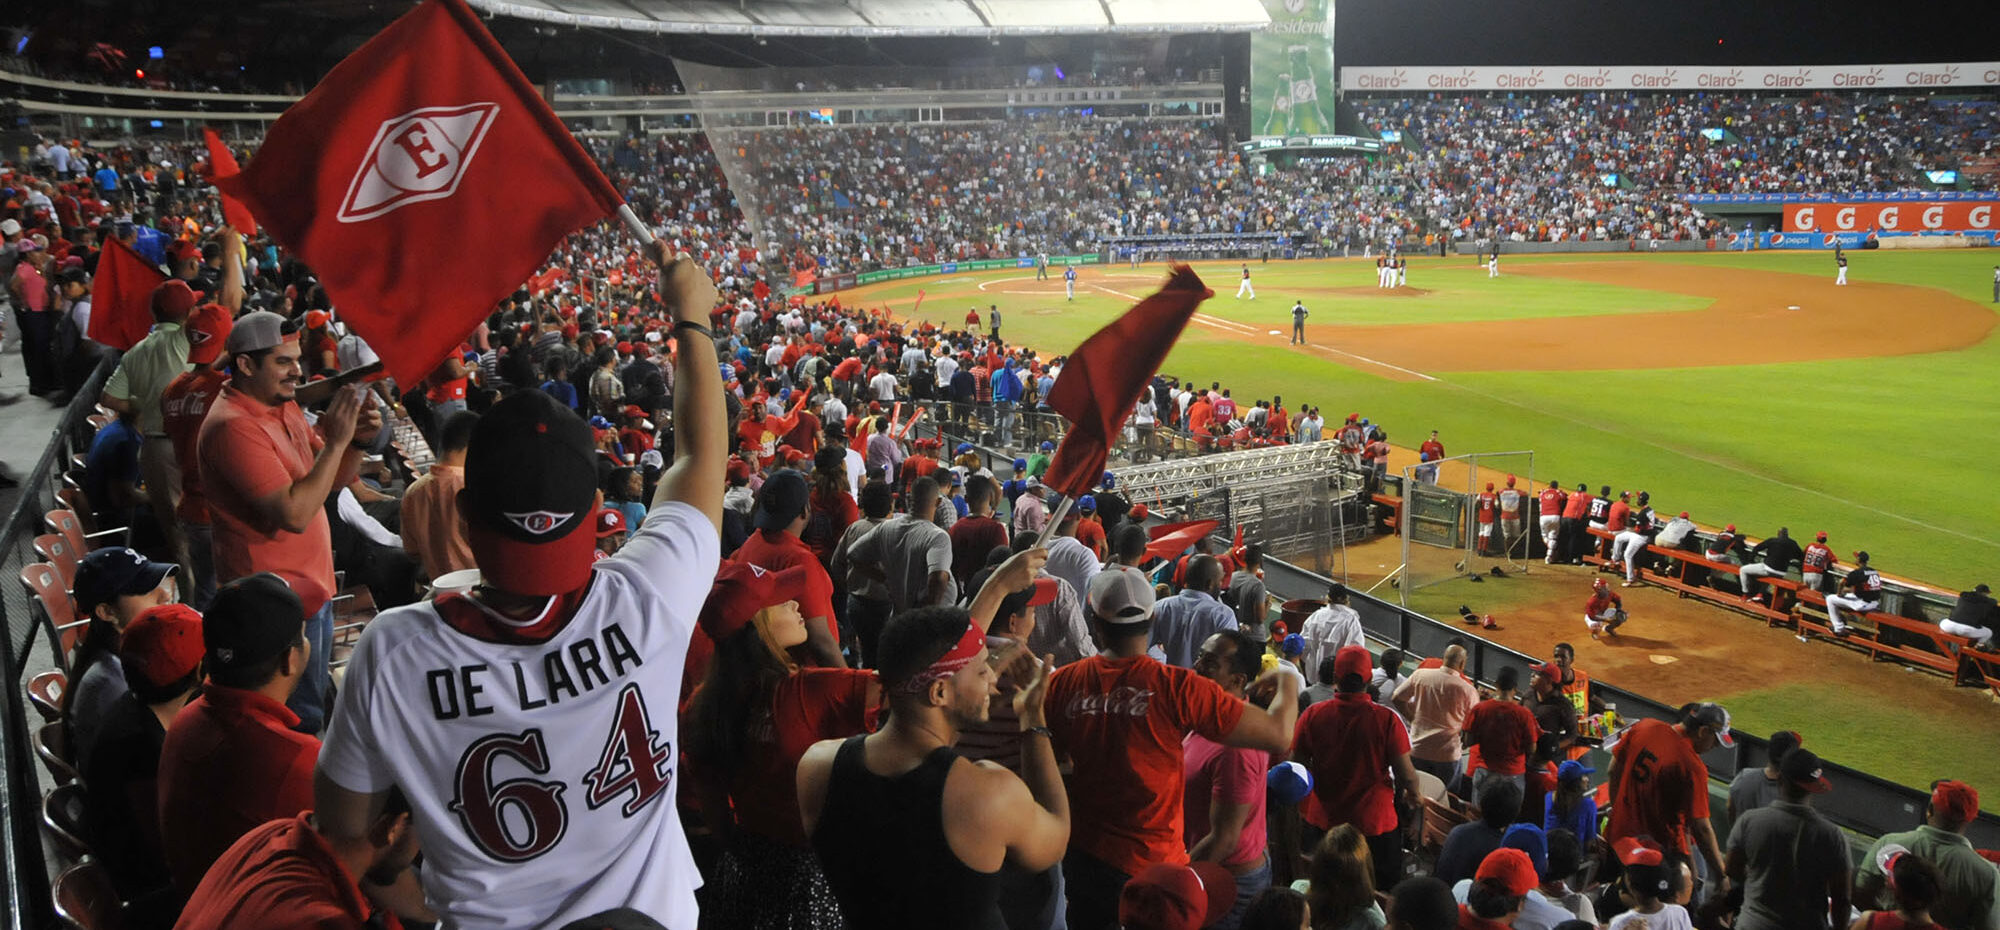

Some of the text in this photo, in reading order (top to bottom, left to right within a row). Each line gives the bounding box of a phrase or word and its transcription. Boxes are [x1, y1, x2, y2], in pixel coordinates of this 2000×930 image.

[1262, 18, 1329, 34] resident
[1358, 73, 1400, 88] Claro
[1427, 73, 1469, 88] Claro
[1496, 73, 1538, 88] Claro
[1564, 73, 1606, 88] Claro
[1631, 73, 1672, 88] Claro
[1697, 73, 1737, 88] Claro
[1763, 73, 1805, 88] Claro
[1833, 73, 1875, 87] Claro
[1906, 71, 1952, 86] Claro
[393, 122, 449, 179] E
[1260, 138, 1283, 148] ZONA
[1795, 207, 1815, 231] G
[1836, 207, 1856, 230] G
[1878, 206, 1899, 230] G
[1922, 205, 1944, 229] G
[1968, 205, 1992, 229] G
[1785, 235, 1809, 246] pepsi
[1218, 404, 1231, 416] 33
[1867, 574, 1880, 587] 49
[426, 622, 643, 720] DE LARA
[447, 681, 673, 863] 64
[1631, 747, 1659, 783] 5
